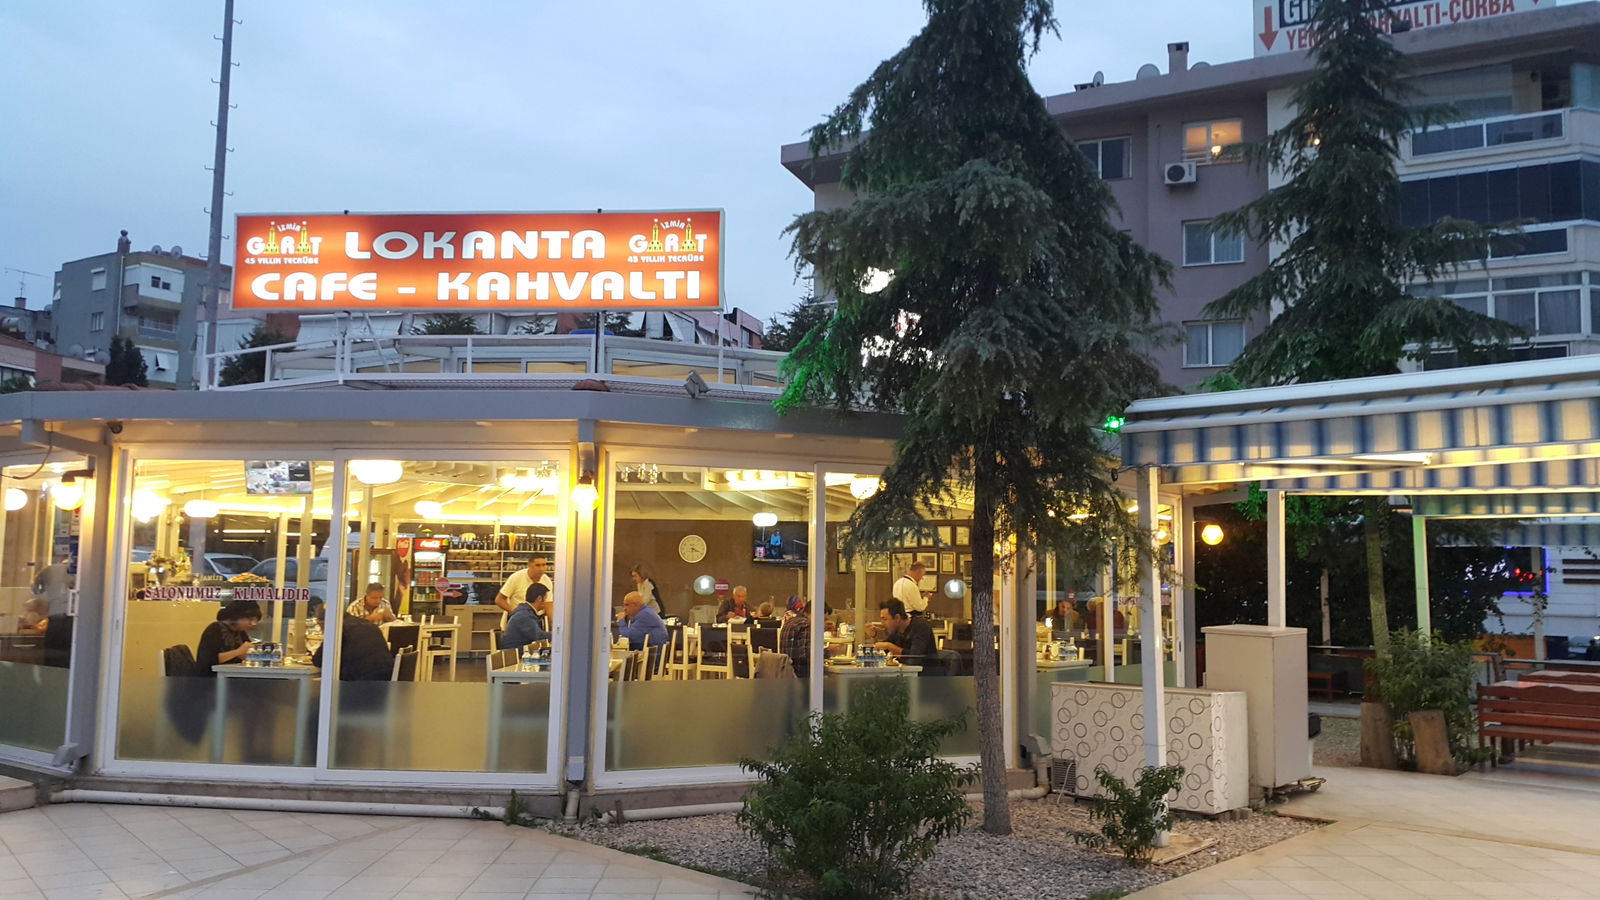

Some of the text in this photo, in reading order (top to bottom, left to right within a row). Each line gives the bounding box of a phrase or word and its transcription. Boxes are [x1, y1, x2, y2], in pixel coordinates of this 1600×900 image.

[345, 230, 606, 260] LOKANTA
[250, 270, 702, 302] CAFE - KAHVALTI
[144, 582, 311, 601] SALONUMUZ KLİMALIDIR
